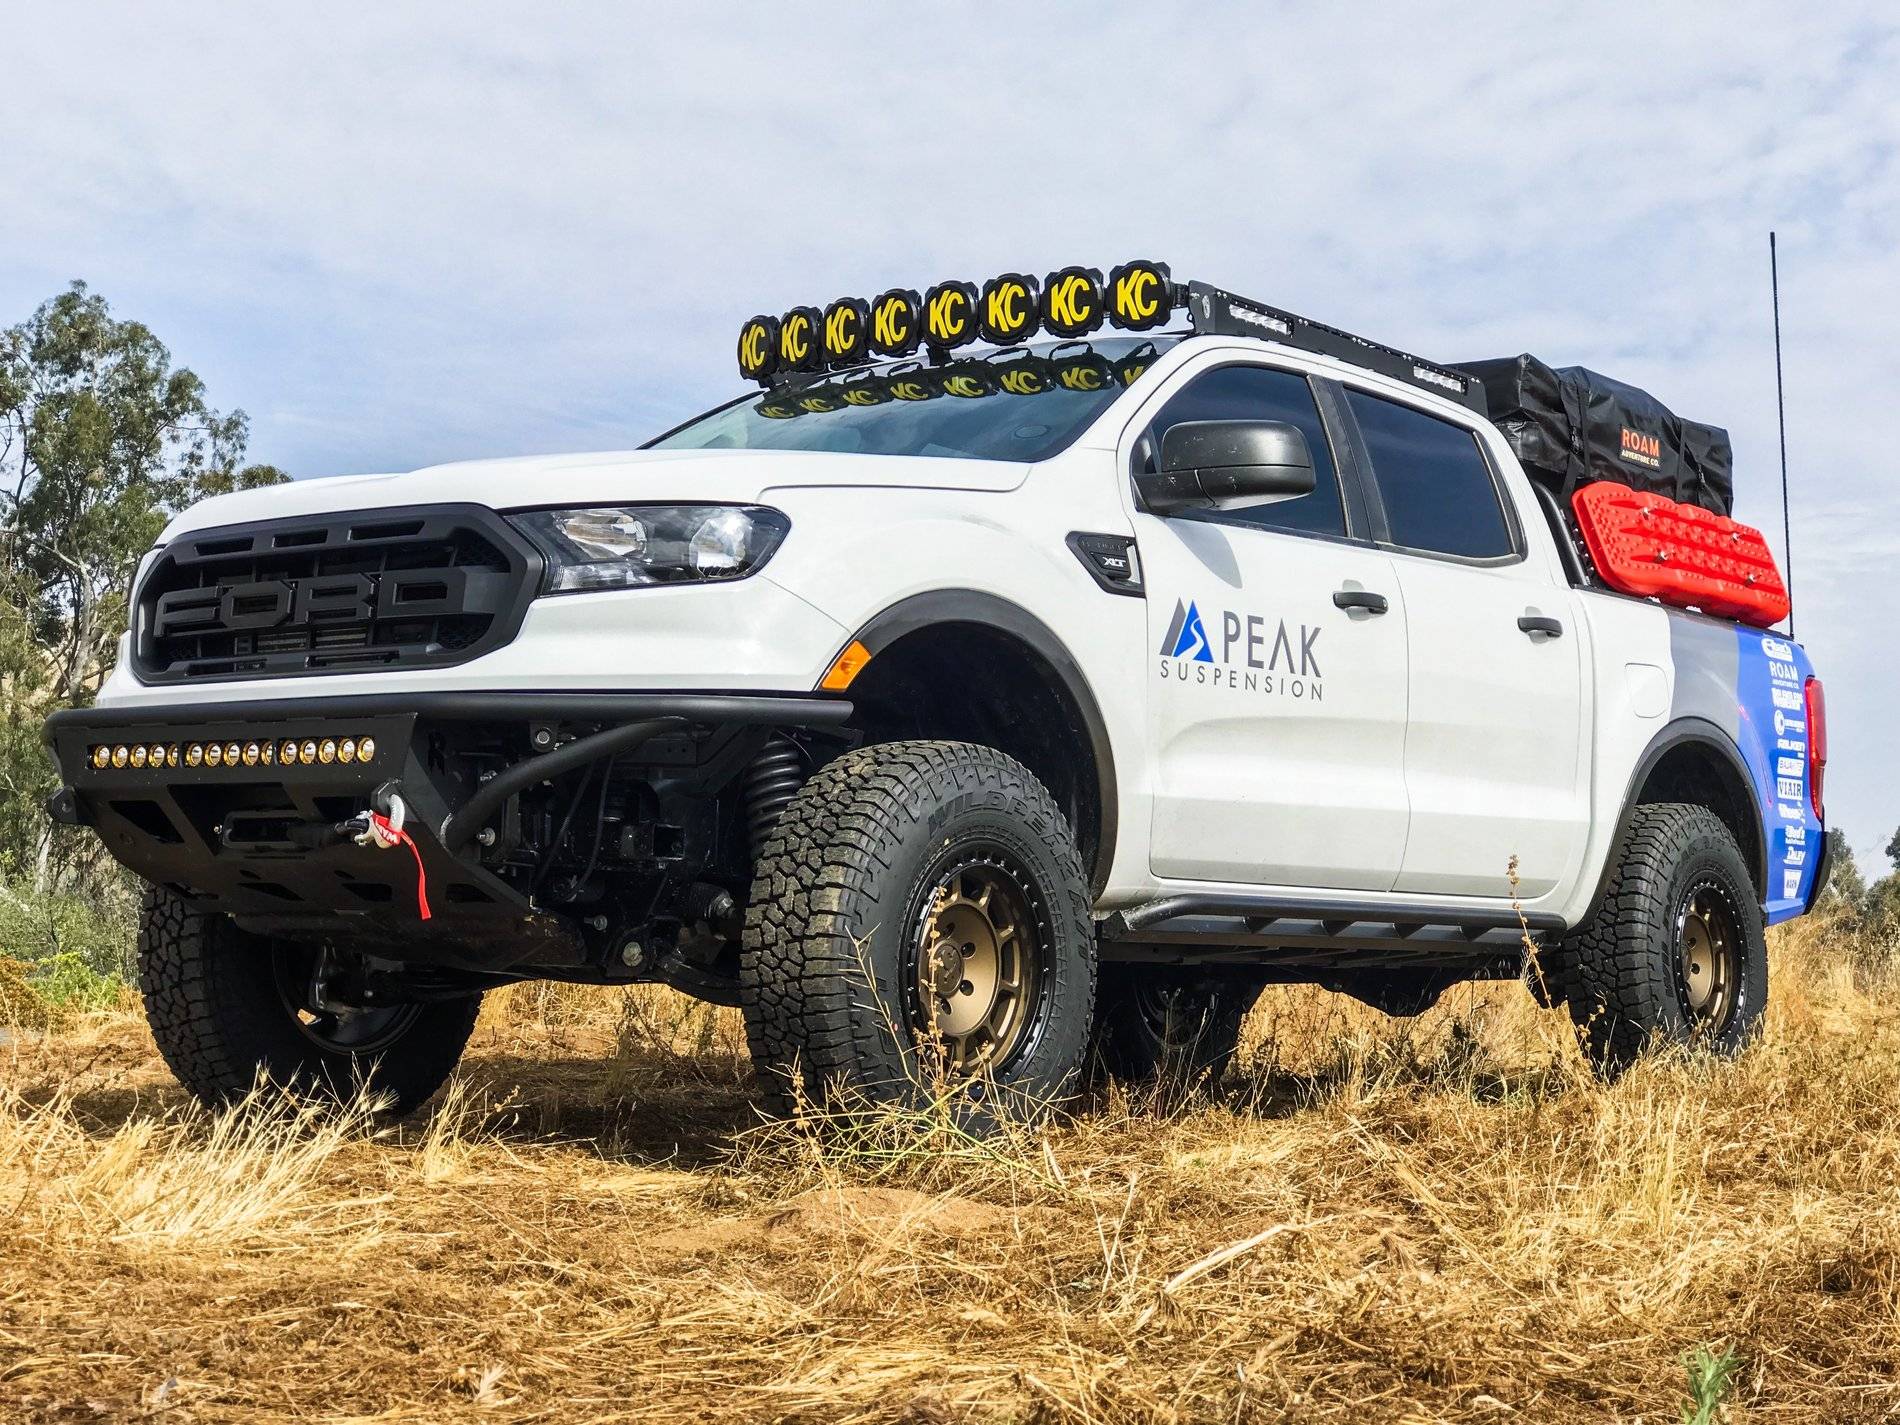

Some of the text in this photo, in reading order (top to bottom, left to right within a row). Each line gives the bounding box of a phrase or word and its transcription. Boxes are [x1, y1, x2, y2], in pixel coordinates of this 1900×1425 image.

[929, 290, 964, 338] KC
[988, 283, 1026, 331] KC
[1050, 276, 1090, 326] KC
[1116, 270, 1158, 320] KC
[781, 317, 808, 362] KC
[825, 308, 855, 354] KC
[874, 299, 907, 346] KC
[741, 324, 766, 369] KC
[1622, 428, 1659, 457] ROAM
[1102, 556, 1126, 568] XLT
[153, 568, 466, 637] FORD
[1223, 610, 1321, 678] PEAK
[1160, 659, 1323, 702] SUSPENSION
[1769, 660, 1799, 681] ROAM
[1779, 781, 1802, 797] VIAIR
